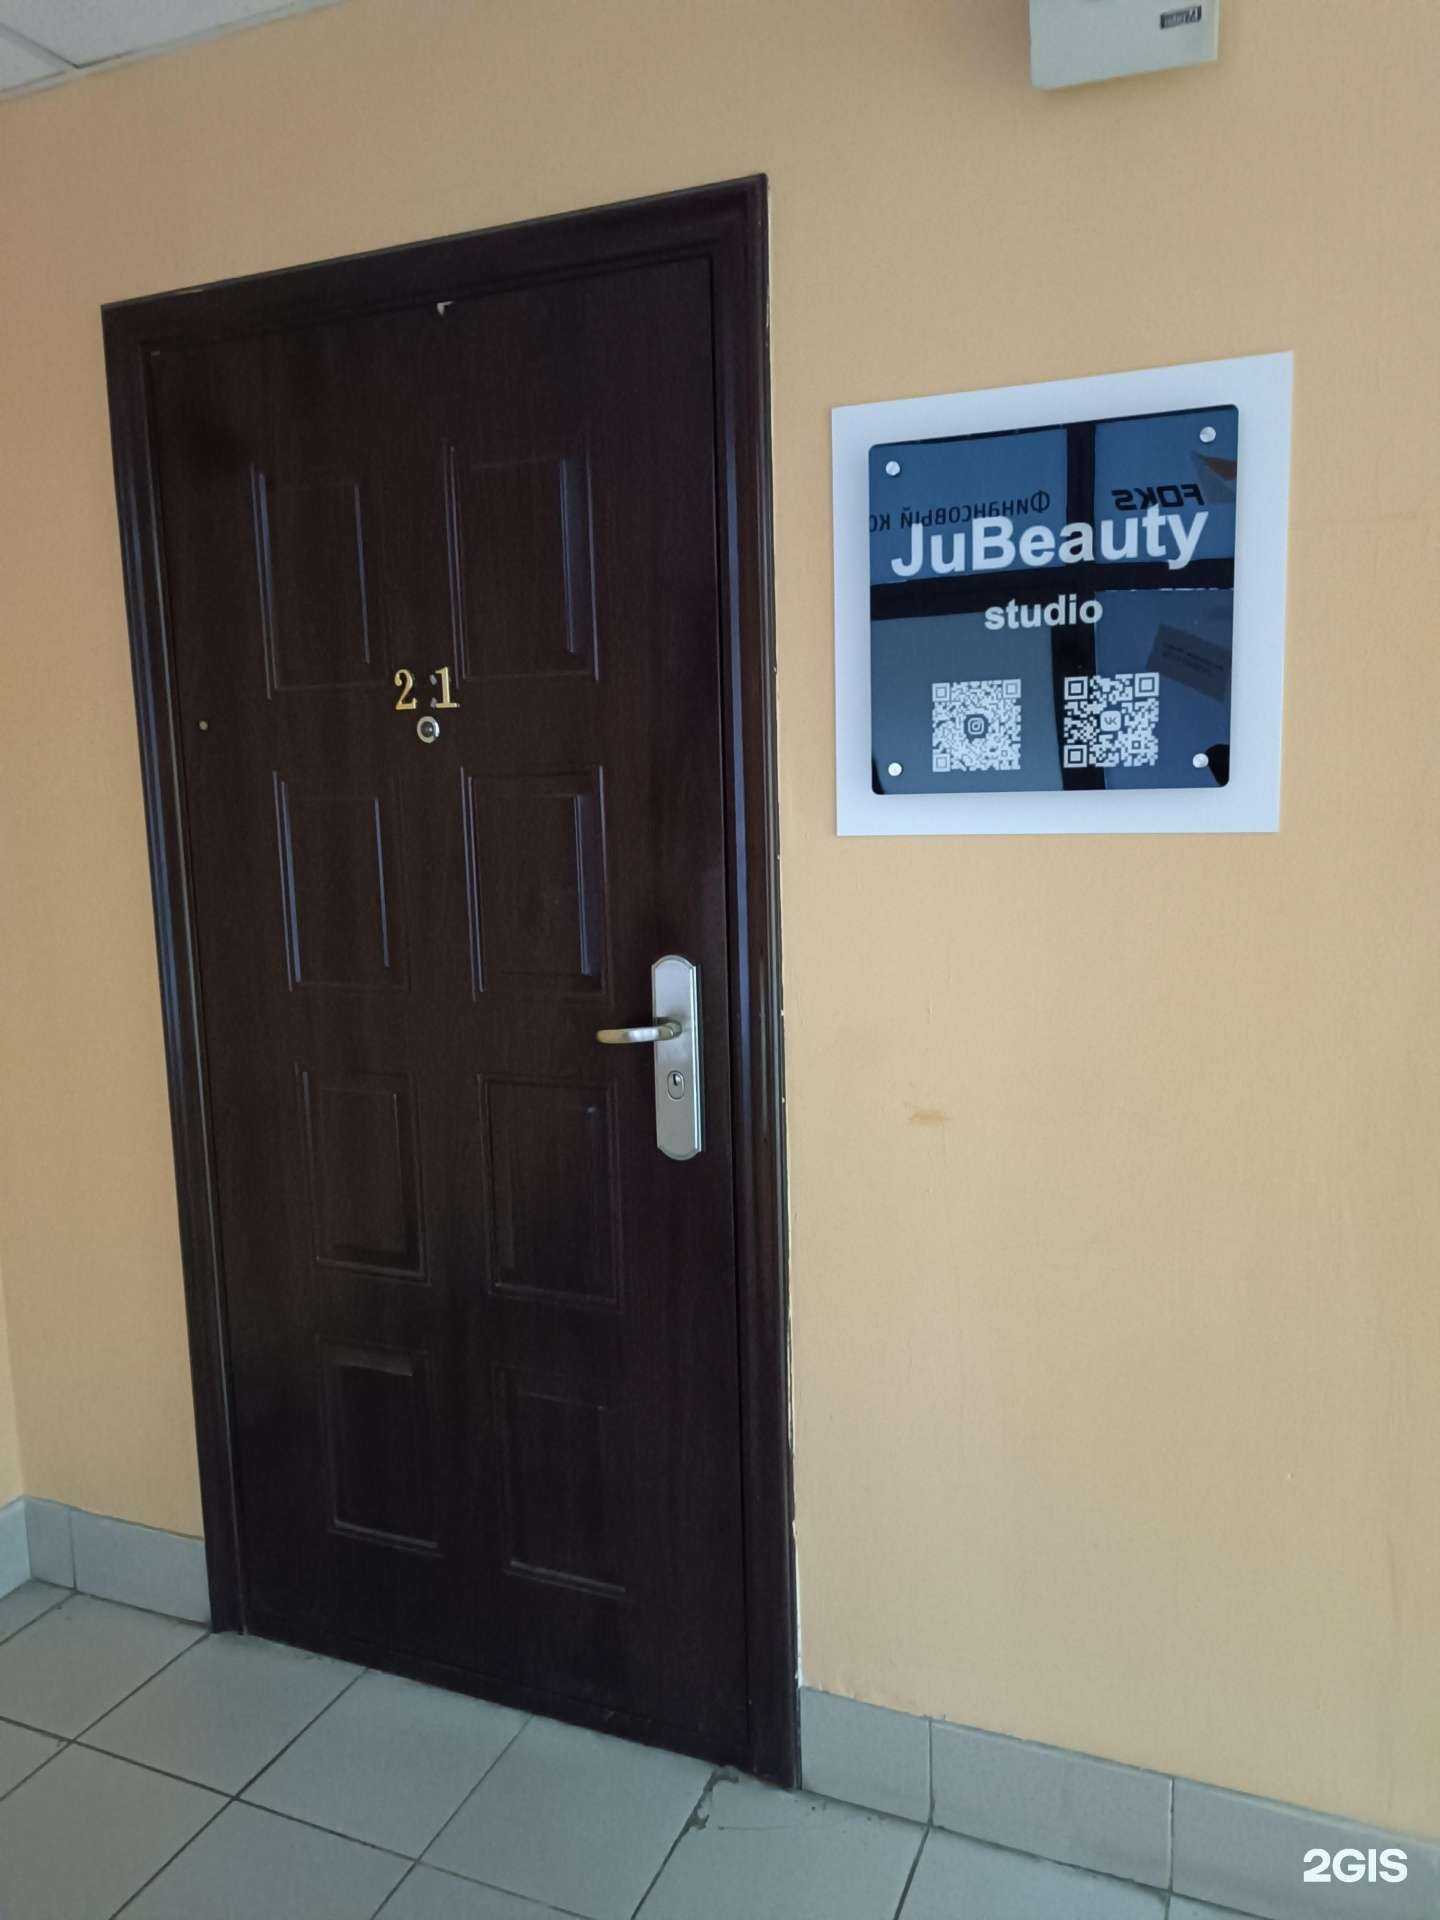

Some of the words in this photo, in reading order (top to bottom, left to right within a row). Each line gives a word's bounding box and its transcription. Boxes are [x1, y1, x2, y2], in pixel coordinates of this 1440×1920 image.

[891, 504, 1208, 577] JuBeauty
[985, 595, 1103, 630] studio
[395, 667, 458, 710] 21
